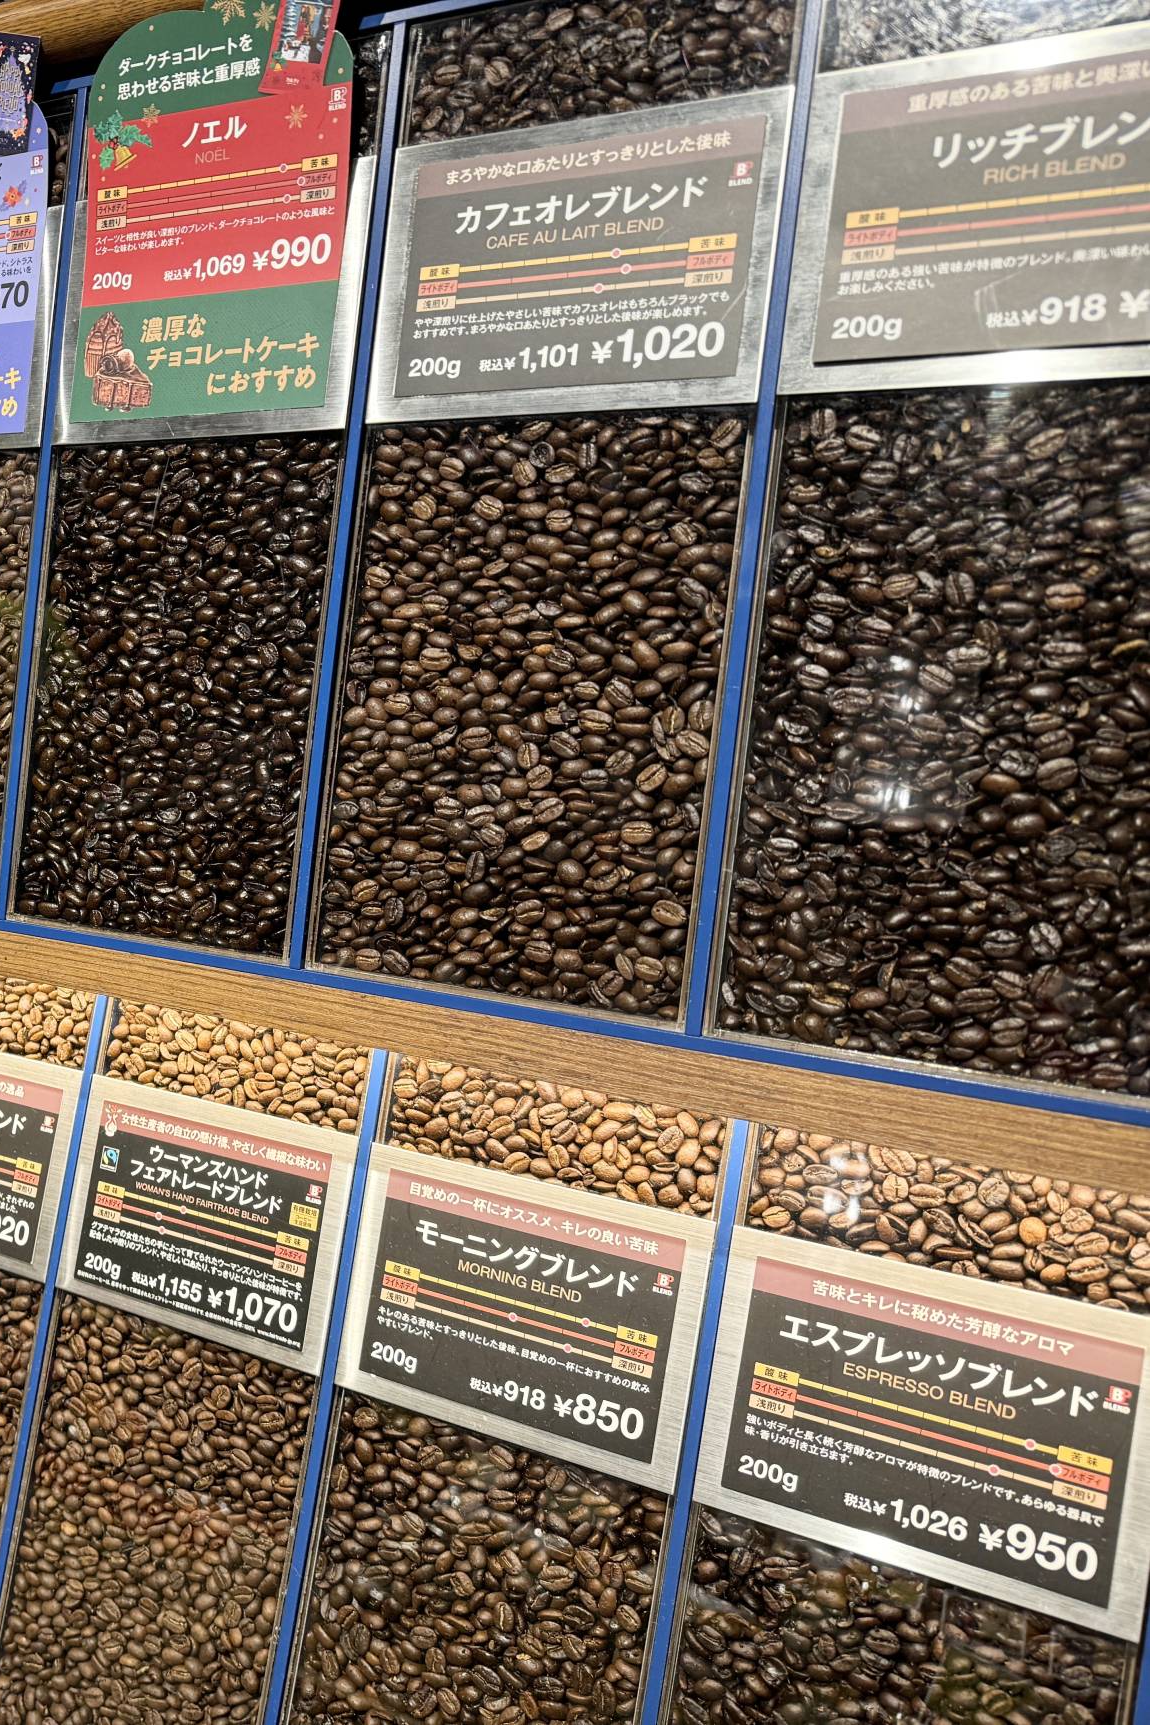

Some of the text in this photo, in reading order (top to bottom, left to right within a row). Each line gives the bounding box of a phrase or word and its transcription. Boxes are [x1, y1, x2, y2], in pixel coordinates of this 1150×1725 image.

[118, 33, 252, 76] ダークチョコレートを
[118, 58, 260, 101] 思わせる苦味と重厚感
[182, 116, 247, 148] ノエル
[446, 131, 732, 185] まろやかな口あたりとすっきりとした後味
[983, 152, 1126, 185] RICH BLEND
[455, 176, 708, 234] カフェオレブレンド
[486, 217, 664, 249] CAFE AU LAIT BLEND
[92, 272, 132, 290] 200g
[253, 233, 330, 271] ¥990
[140, 314, 207, 343] 濃厚な
[831, 315, 902, 340] 200g
[147, 333, 320, 369] チョコレートケーキ
[408, 356, 461, 379] 200g
[591, 322, 725, 368] ¥1,020
[207, 365, 316, 395] におすすめ
[130, 1160, 282, 1214] フェアトレードブレンド
[149, 1145, 268, 1189] ウーマンズハンド
[136, 1181, 269, 1224] WOMAN'S HAND FAIRTRADE BLEND
[410, 1181, 659, 1256] 目覚めの一杯にオススメ、キレの良い苦味
[416, 1219, 638, 1297] モーニングブレンド
[84, 1253, 120, 1280] 200g
[207, 1287, 298, 1333] ¥1,070
[457, 1259, 582, 1303] MORNING BLEND
[376, 1315, 434, 1341] やすいブレンド。
[813, 1279, 1074, 1357] 苦味とキレに秘めた芳醇なアロマ
[779, 1315, 1099, 1417] エスプレッソブレンド
[371, 1342, 417, 1374] 200g
[553, 1394, 644, 1440] ¥850
[754, 1380, 793, 1399] ライトボディ
[842, 1362, 1016, 1420] ESPRESSO BLEND
[744, 1425, 853, 1466] 味・香りが引き立ちます。
[738, 1454, 799, 1493] 200g
[979, 1523, 1098, 1581] ¥950
